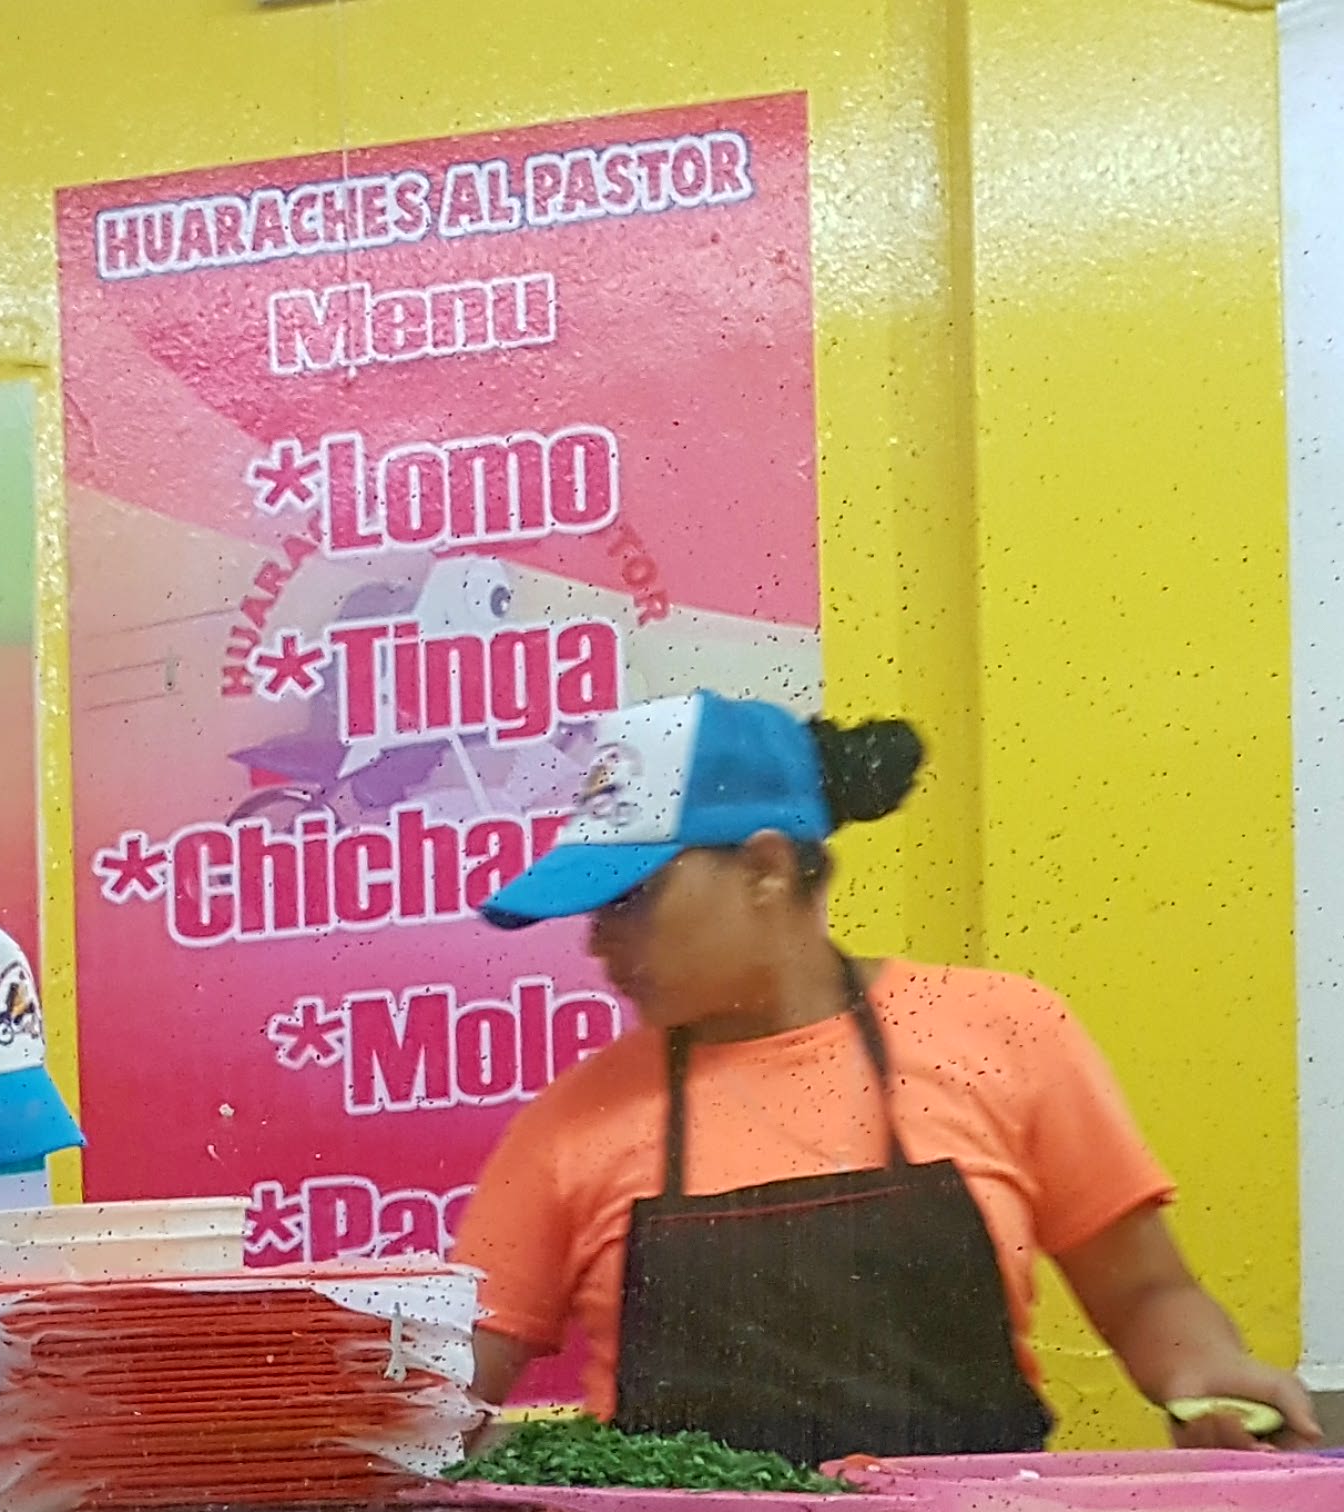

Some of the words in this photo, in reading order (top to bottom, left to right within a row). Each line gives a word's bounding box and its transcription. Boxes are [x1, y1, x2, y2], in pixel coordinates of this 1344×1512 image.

[98, 172, 431, 279] HUARACHES
[437, 160, 521, 238] AL
[525, 130, 754, 226] PASTOR
[269, 273, 559, 376] Menu
